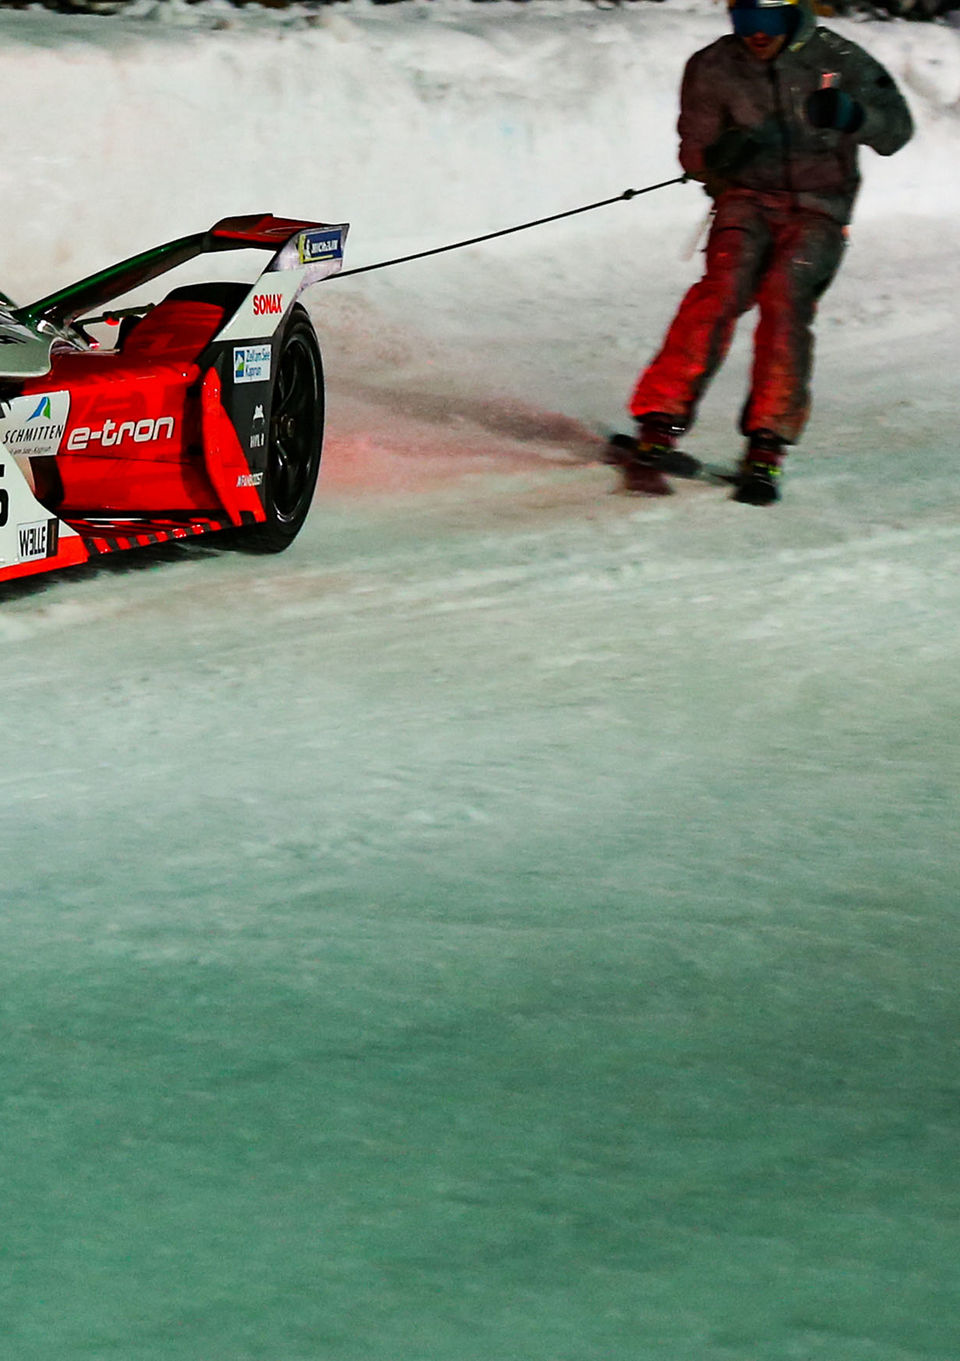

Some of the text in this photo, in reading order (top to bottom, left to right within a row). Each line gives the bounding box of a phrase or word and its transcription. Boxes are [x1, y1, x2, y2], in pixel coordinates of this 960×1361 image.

[253, 293, 282, 316] SONAX
[2, 424, 64, 445] SCHMITTEN
[67, 416, 174, 451] e-tron
